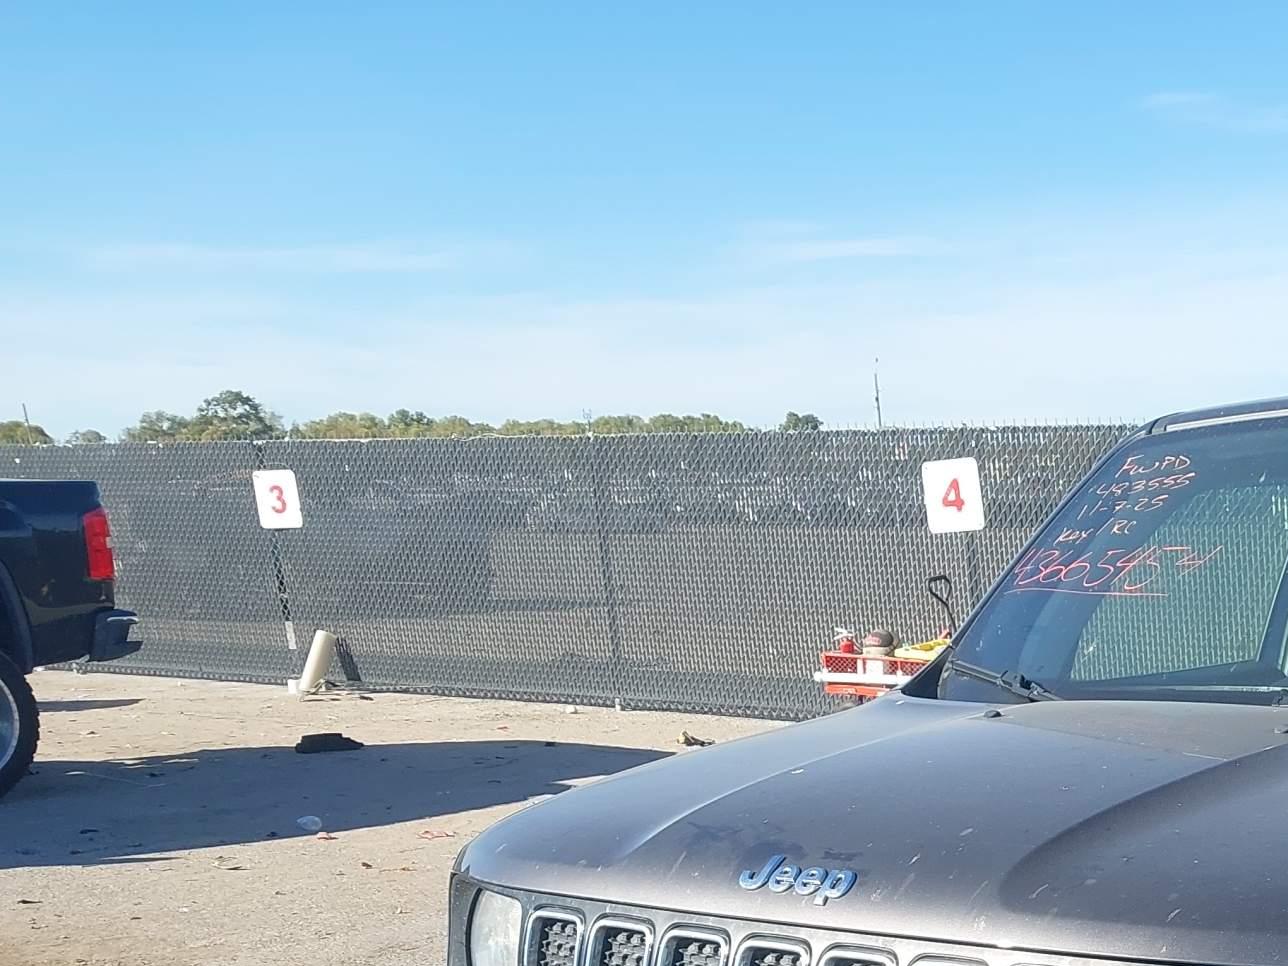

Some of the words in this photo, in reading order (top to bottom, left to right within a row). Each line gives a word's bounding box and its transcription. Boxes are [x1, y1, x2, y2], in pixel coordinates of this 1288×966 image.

[269, 485, 287, 514] 3
[942, 478, 965, 512] 4
[739, 854, 857, 906] Jeep
